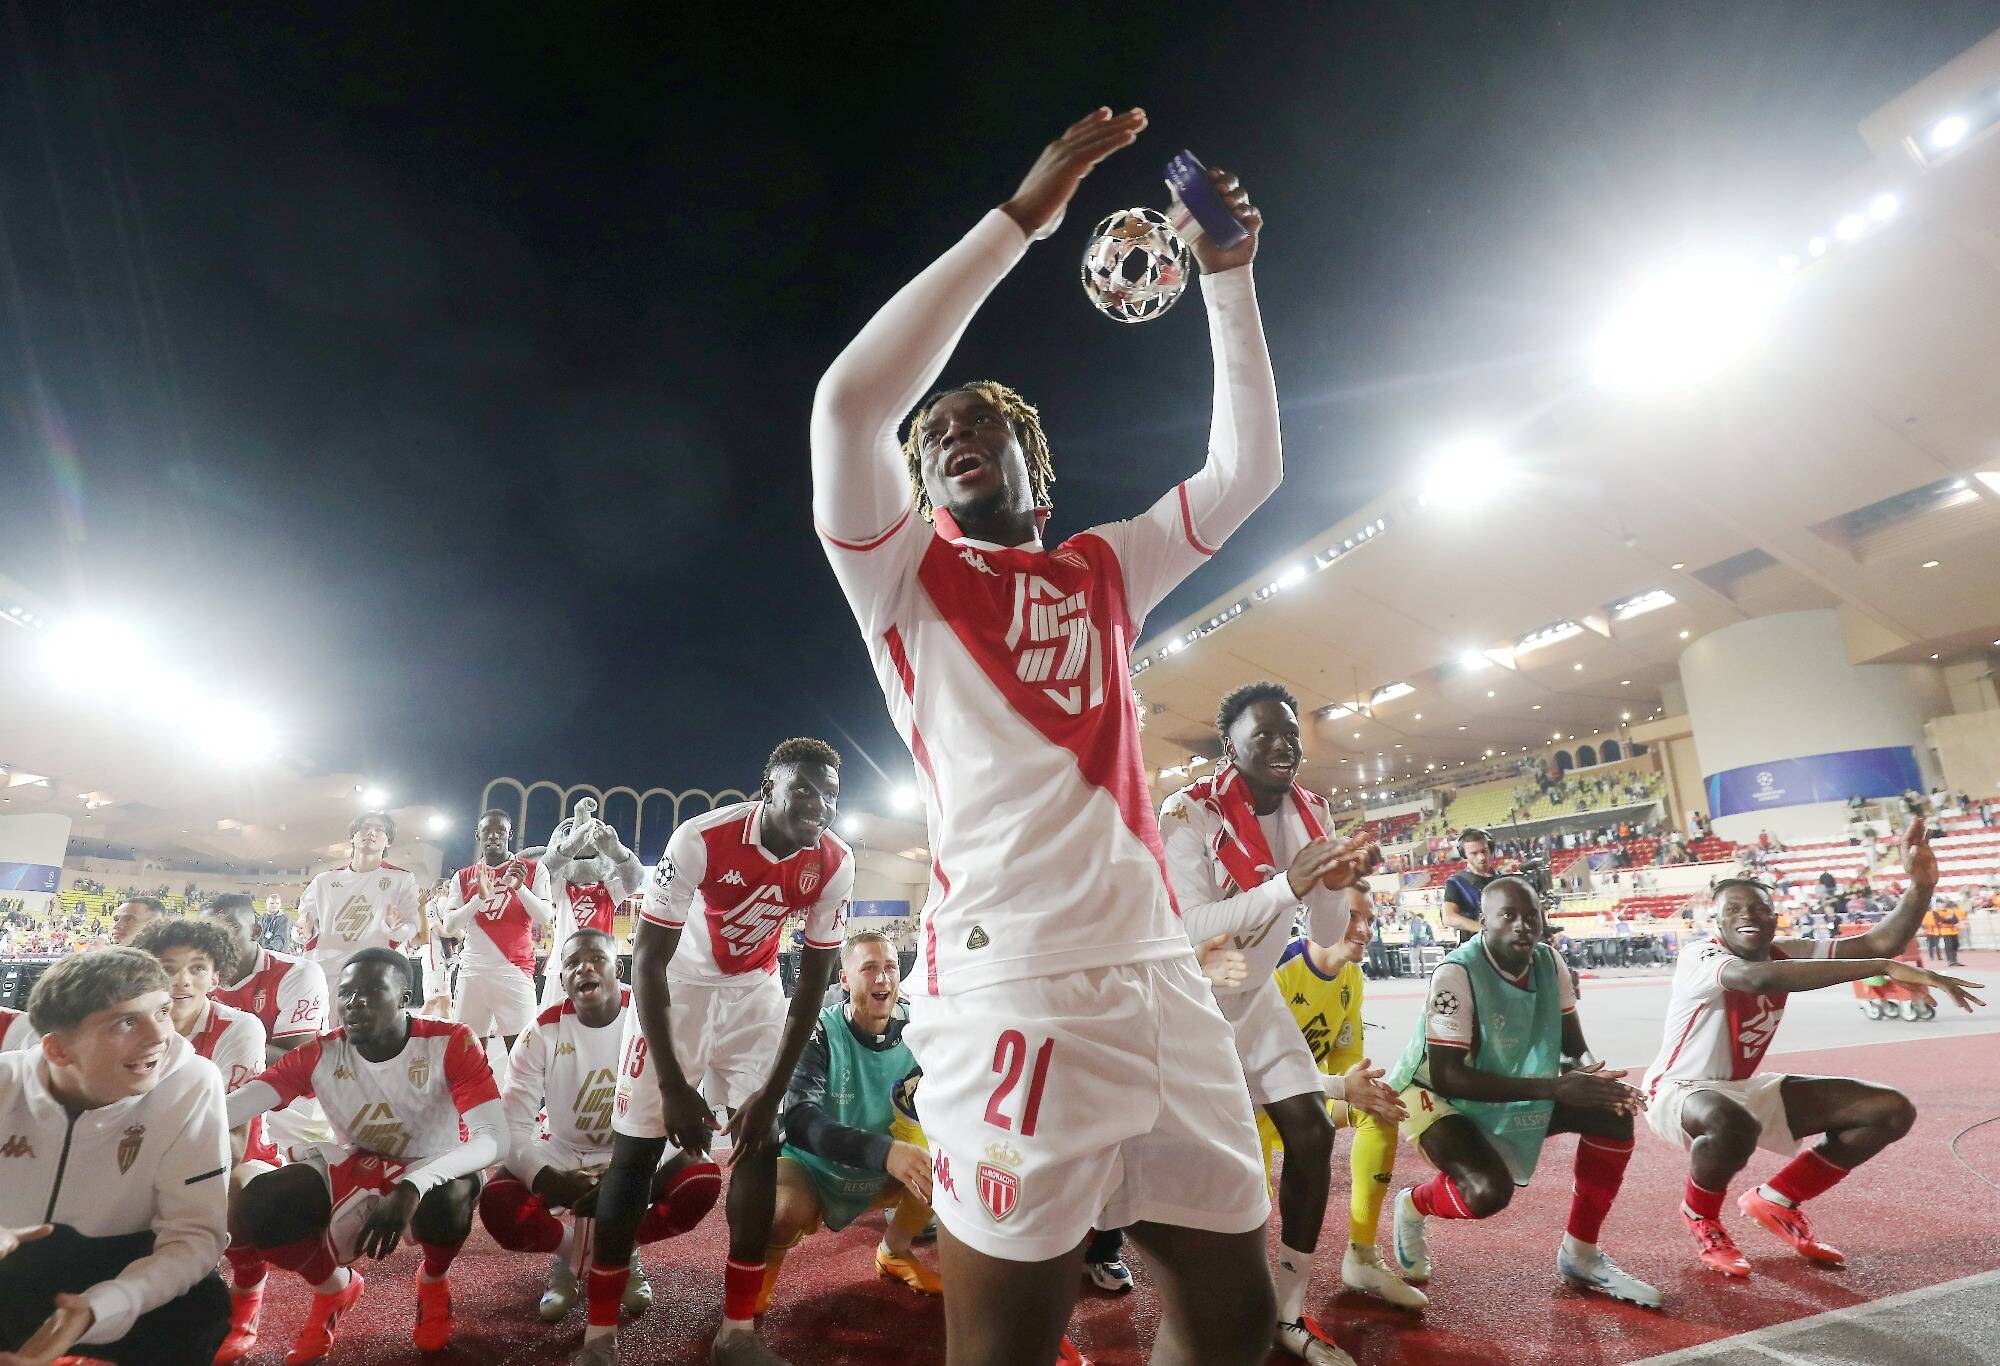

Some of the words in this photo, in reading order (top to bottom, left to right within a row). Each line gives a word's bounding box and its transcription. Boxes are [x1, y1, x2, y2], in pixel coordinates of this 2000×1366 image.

[622, 1035, 648, 1079] 13
[984, 1029, 1055, 1137] 21
[1420, 1090, 1434, 1113] 4
